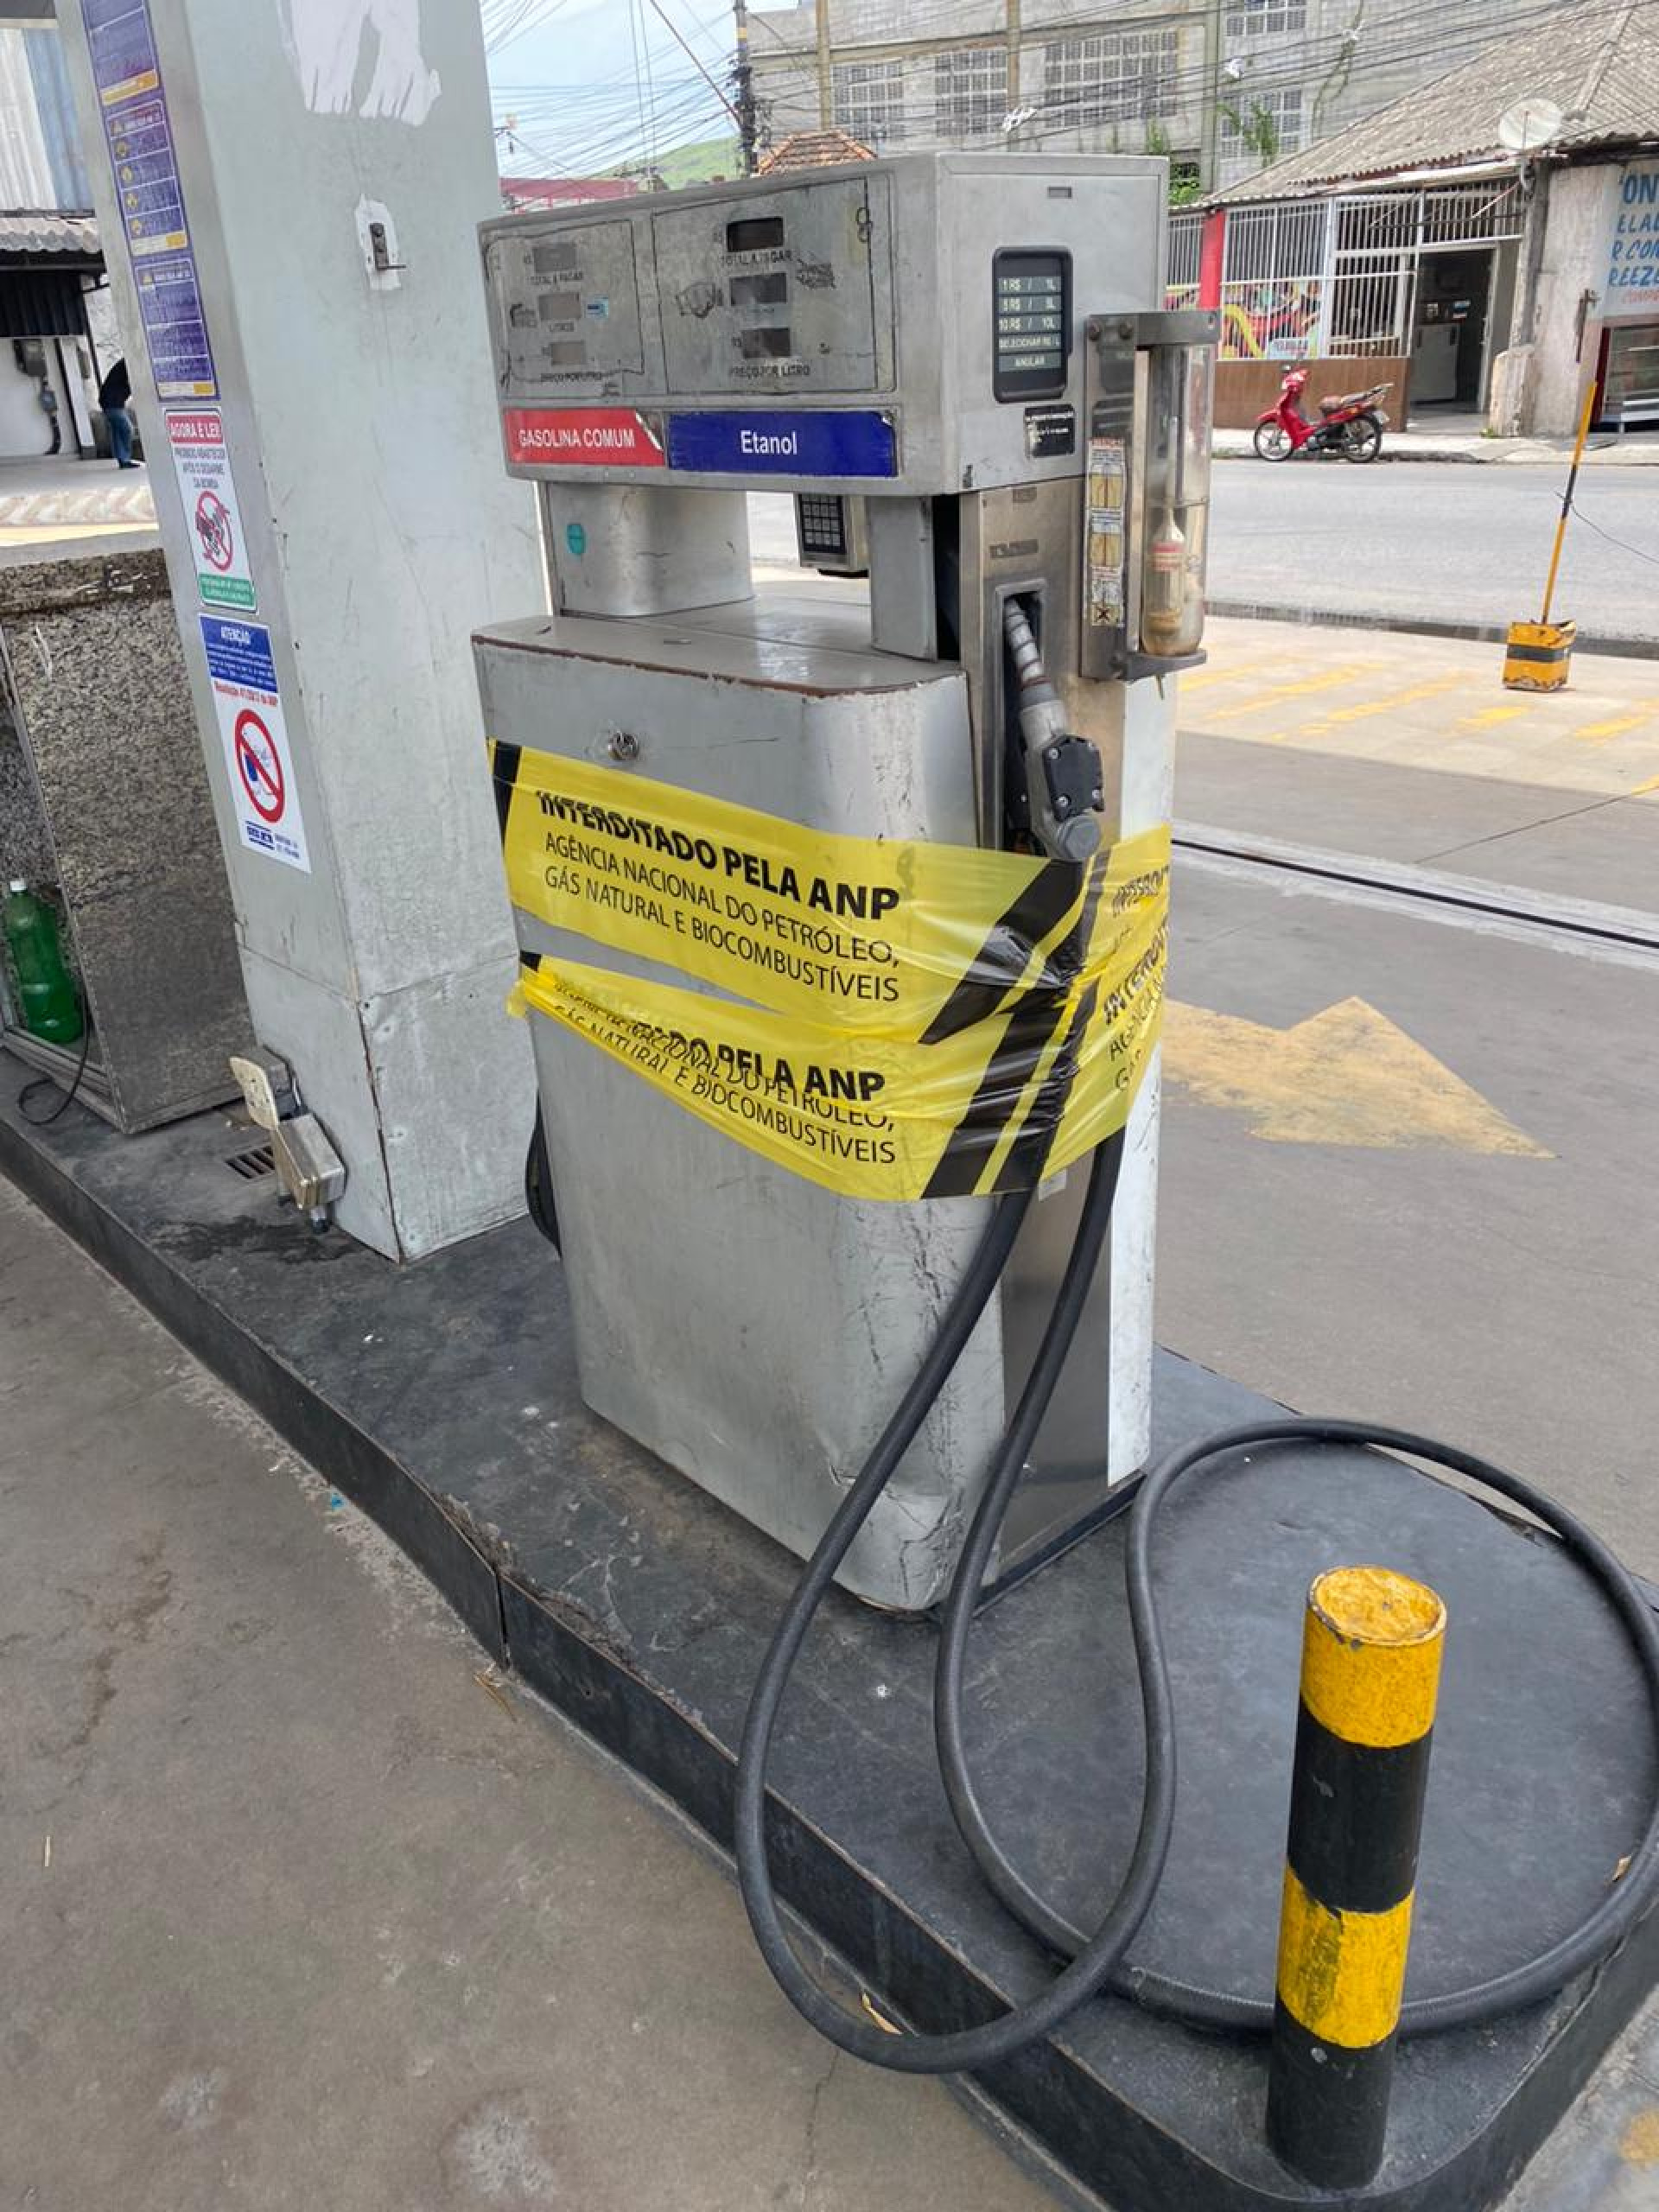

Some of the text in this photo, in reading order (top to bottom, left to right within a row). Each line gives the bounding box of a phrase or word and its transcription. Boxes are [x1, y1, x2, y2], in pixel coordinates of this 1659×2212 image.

[518, 428, 636, 448] GASOLINA COMUM
[740, 430, 798, 454] Etanol
[535, 790, 899, 920] INTERDITADO PELA ANP
[545, 831, 899, 968] AGÊNCIA NACIONAL DO PETRÓLEO,
[544, 866, 899, 1001] GÁS NATURAL E BIOCOMBUSTÍVEIS
[691, 1073, 896, 1164] BIOCOMBUSTÍVEIS
[804, 1065, 886, 1102] ANP
